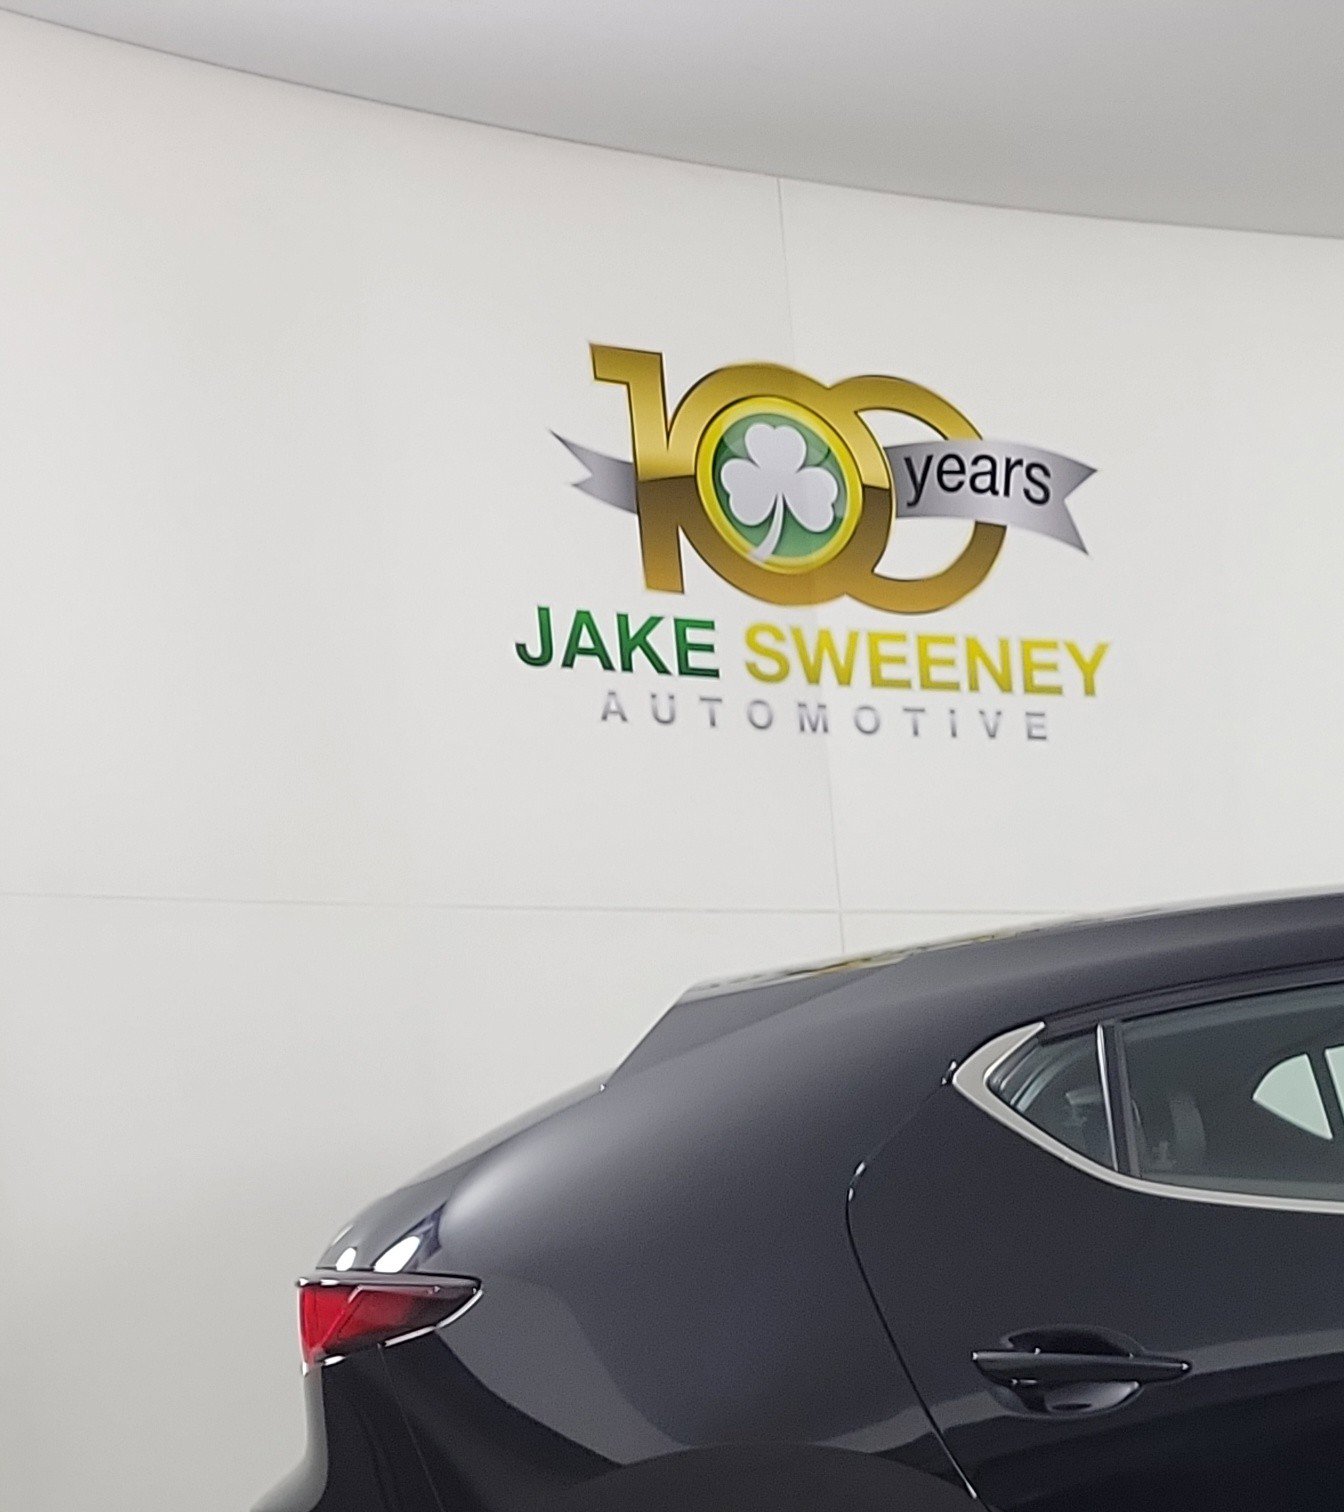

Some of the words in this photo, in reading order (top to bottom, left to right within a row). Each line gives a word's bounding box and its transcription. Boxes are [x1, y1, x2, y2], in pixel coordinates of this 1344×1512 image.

[588, 341, 1008, 616] 100
[904, 450, 1052, 507] years
[514, 605, 721, 680] JAKE
[743, 621, 1112, 698] SWEENEY
[600, 690, 1049, 742] AUTOMOTIVE
